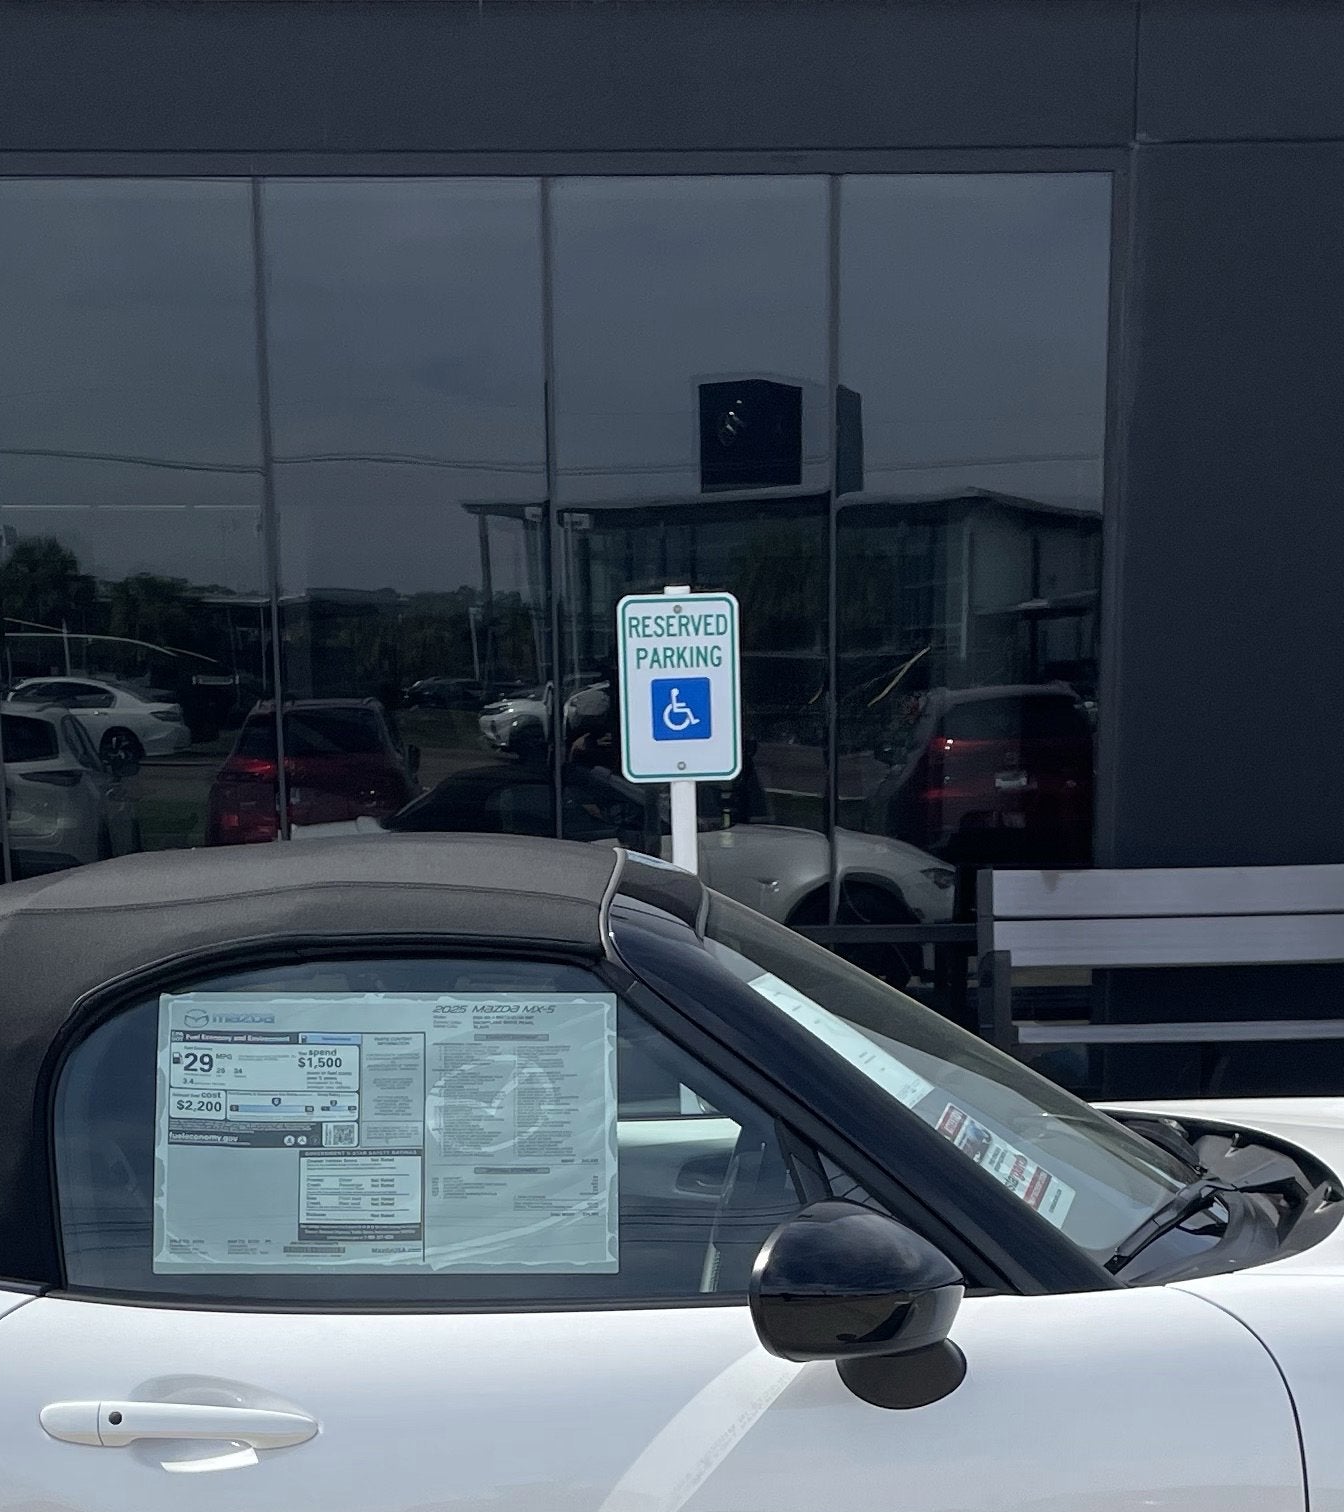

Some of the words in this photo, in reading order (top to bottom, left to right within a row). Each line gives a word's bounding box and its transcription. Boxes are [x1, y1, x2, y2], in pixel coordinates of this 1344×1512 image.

[628, 613, 728, 638] RESERVED
[635, 645, 722, 669] PARKING
[432, 1005, 467, 1014] 2025
[522, 1005, 556, 1014] MX-5
[183, 1053, 214, 1073] 29
[297, 1057, 343, 1069] $1,500
[176, 1100, 222, 1112] $2,200
